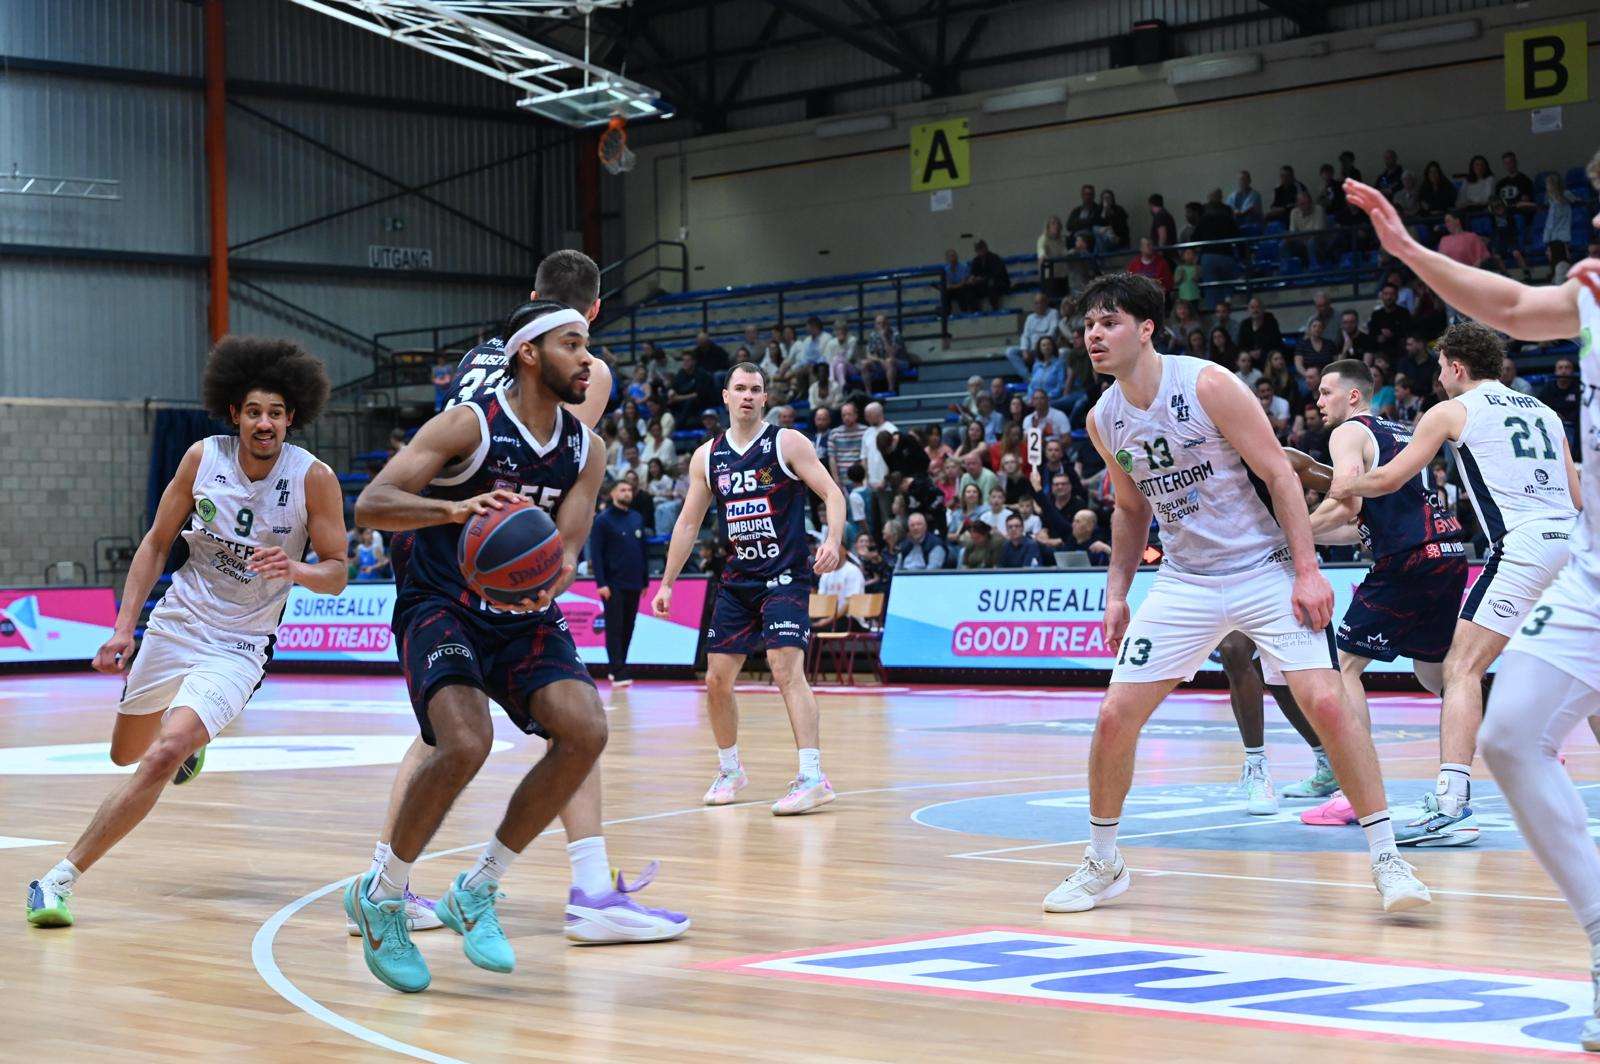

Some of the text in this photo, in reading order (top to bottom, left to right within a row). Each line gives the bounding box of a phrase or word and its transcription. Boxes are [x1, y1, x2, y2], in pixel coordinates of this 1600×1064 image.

[1523, 36, 1568, 100] B
[922, 129, 959, 184] A
[1030, 432, 1039, 451] 2
[1504, 417, 1557, 460] 21
[1143, 437, 1175, 470] 13
[731, 469, 758, 494] 25
[728, 503, 767, 517] Hubo
[1156, 496, 1188, 513] Zeeuw
[1164, 503, 1200, 523] Zeeuw
[234, 508, 254, 537] 9
[215, 561, 252, 585] Zeeuw
[293, 598, 388, 616] SURREALLY
[978, 588, 1107, 612] SURREALL
[279, 626, 390, 648] GOOD TREATS
[954, 626, 1104, 652] GOOD TREA
[1118, 637, 1152, 666] 13
